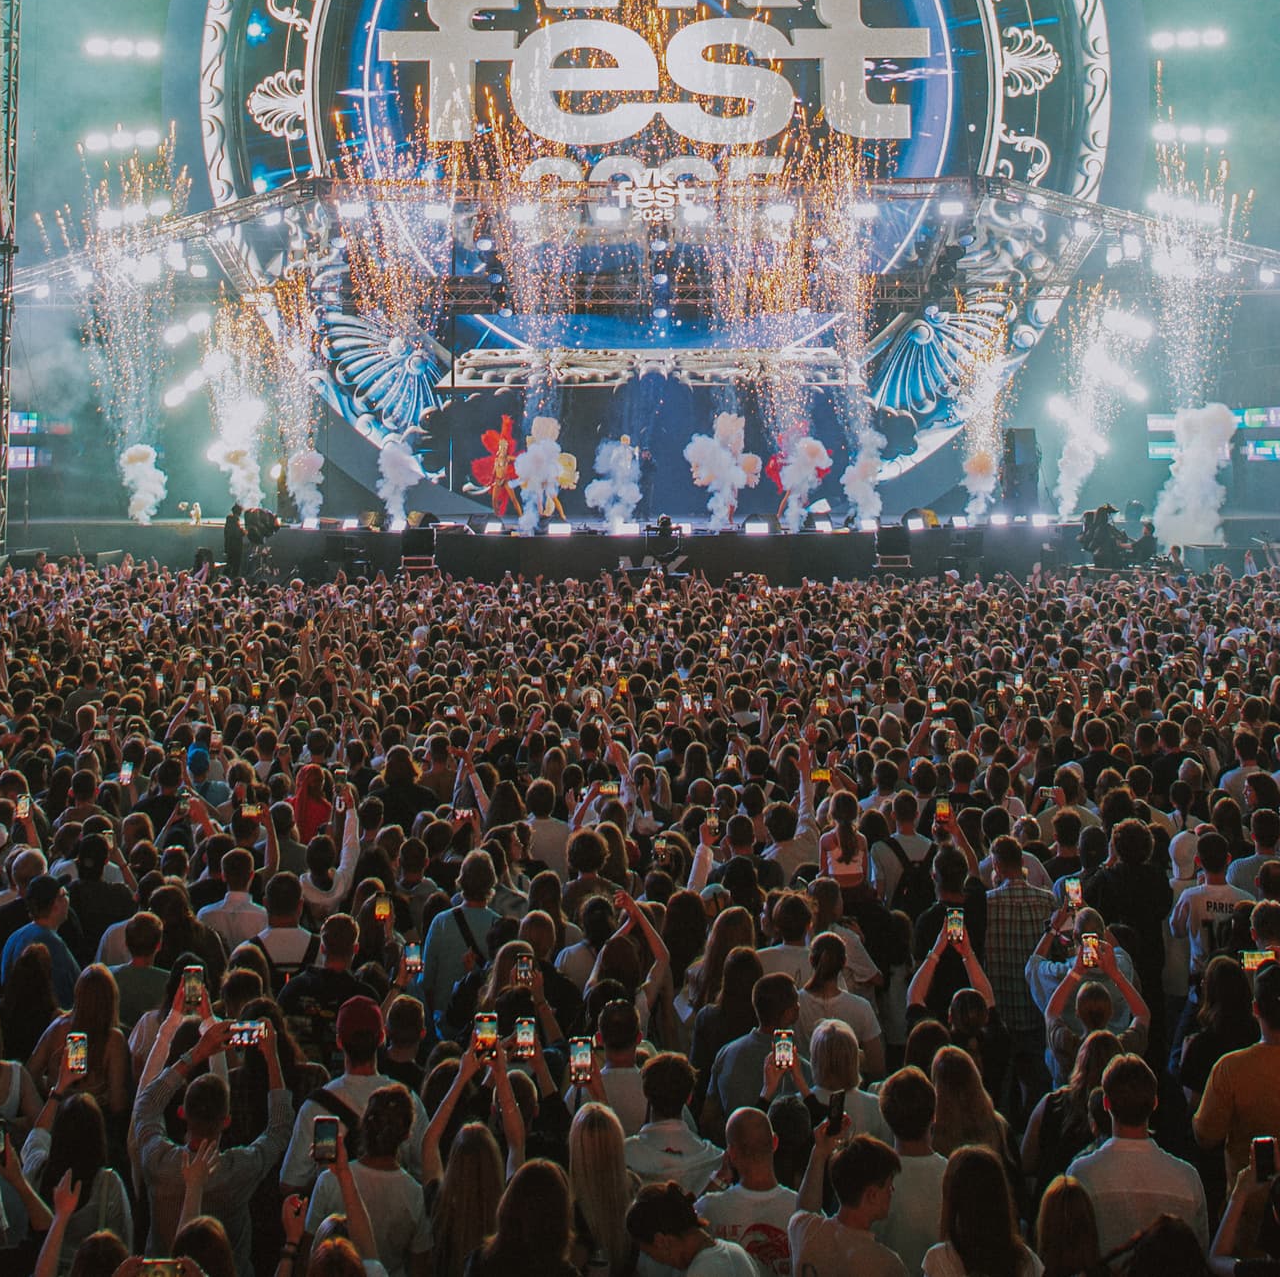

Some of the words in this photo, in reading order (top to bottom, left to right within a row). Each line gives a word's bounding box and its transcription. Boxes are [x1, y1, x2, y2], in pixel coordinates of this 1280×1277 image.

[631, 168, 676, 186] VK
[612, 181, 696, 209] fest
[632, 208, 675, 222] 2025
[1206, 901, 1234, 914] PARIS
